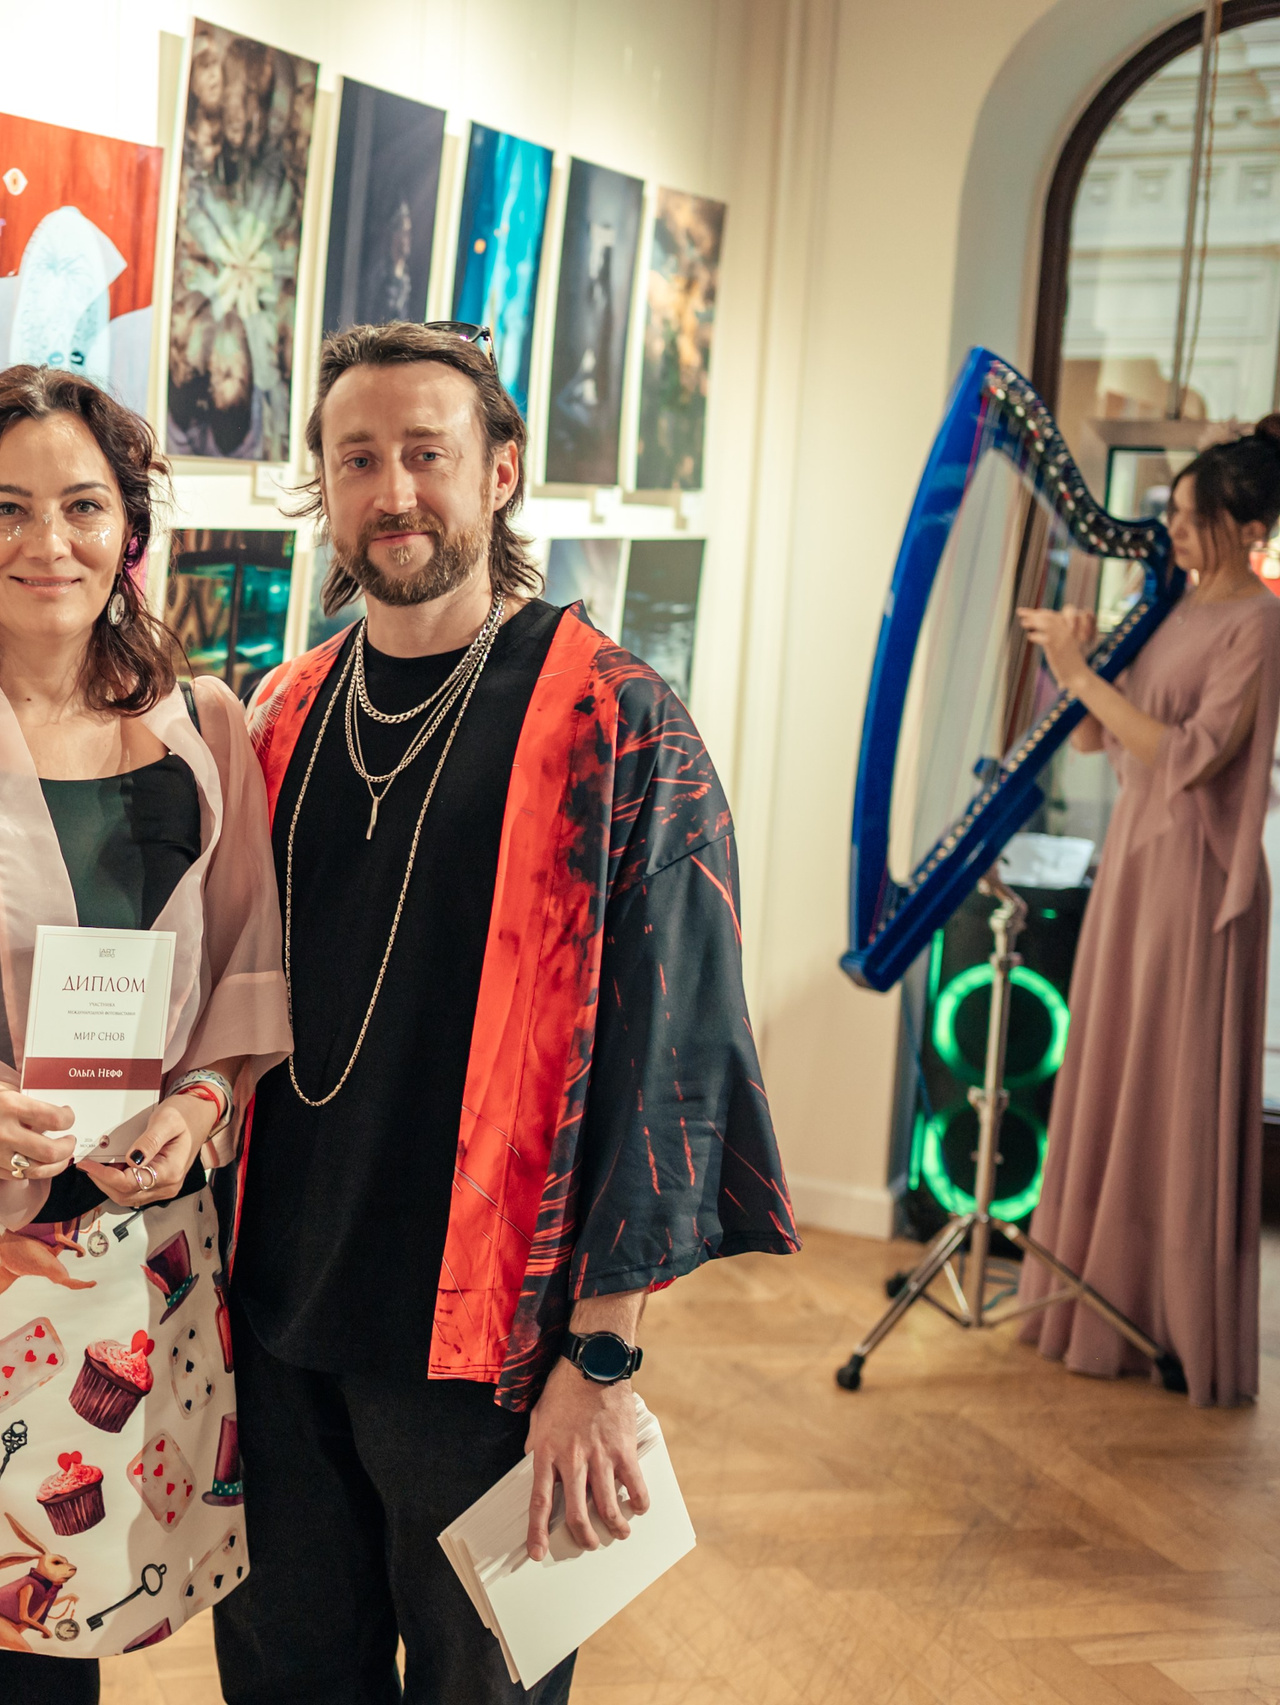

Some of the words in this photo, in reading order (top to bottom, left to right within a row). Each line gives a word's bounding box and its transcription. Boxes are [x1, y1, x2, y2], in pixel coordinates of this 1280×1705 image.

[62, 975, 145, 993] ДИПЛОМ
[73, 1032, 96, 1041] МИР
[97, 1032, 126, 1042] СНОВ
